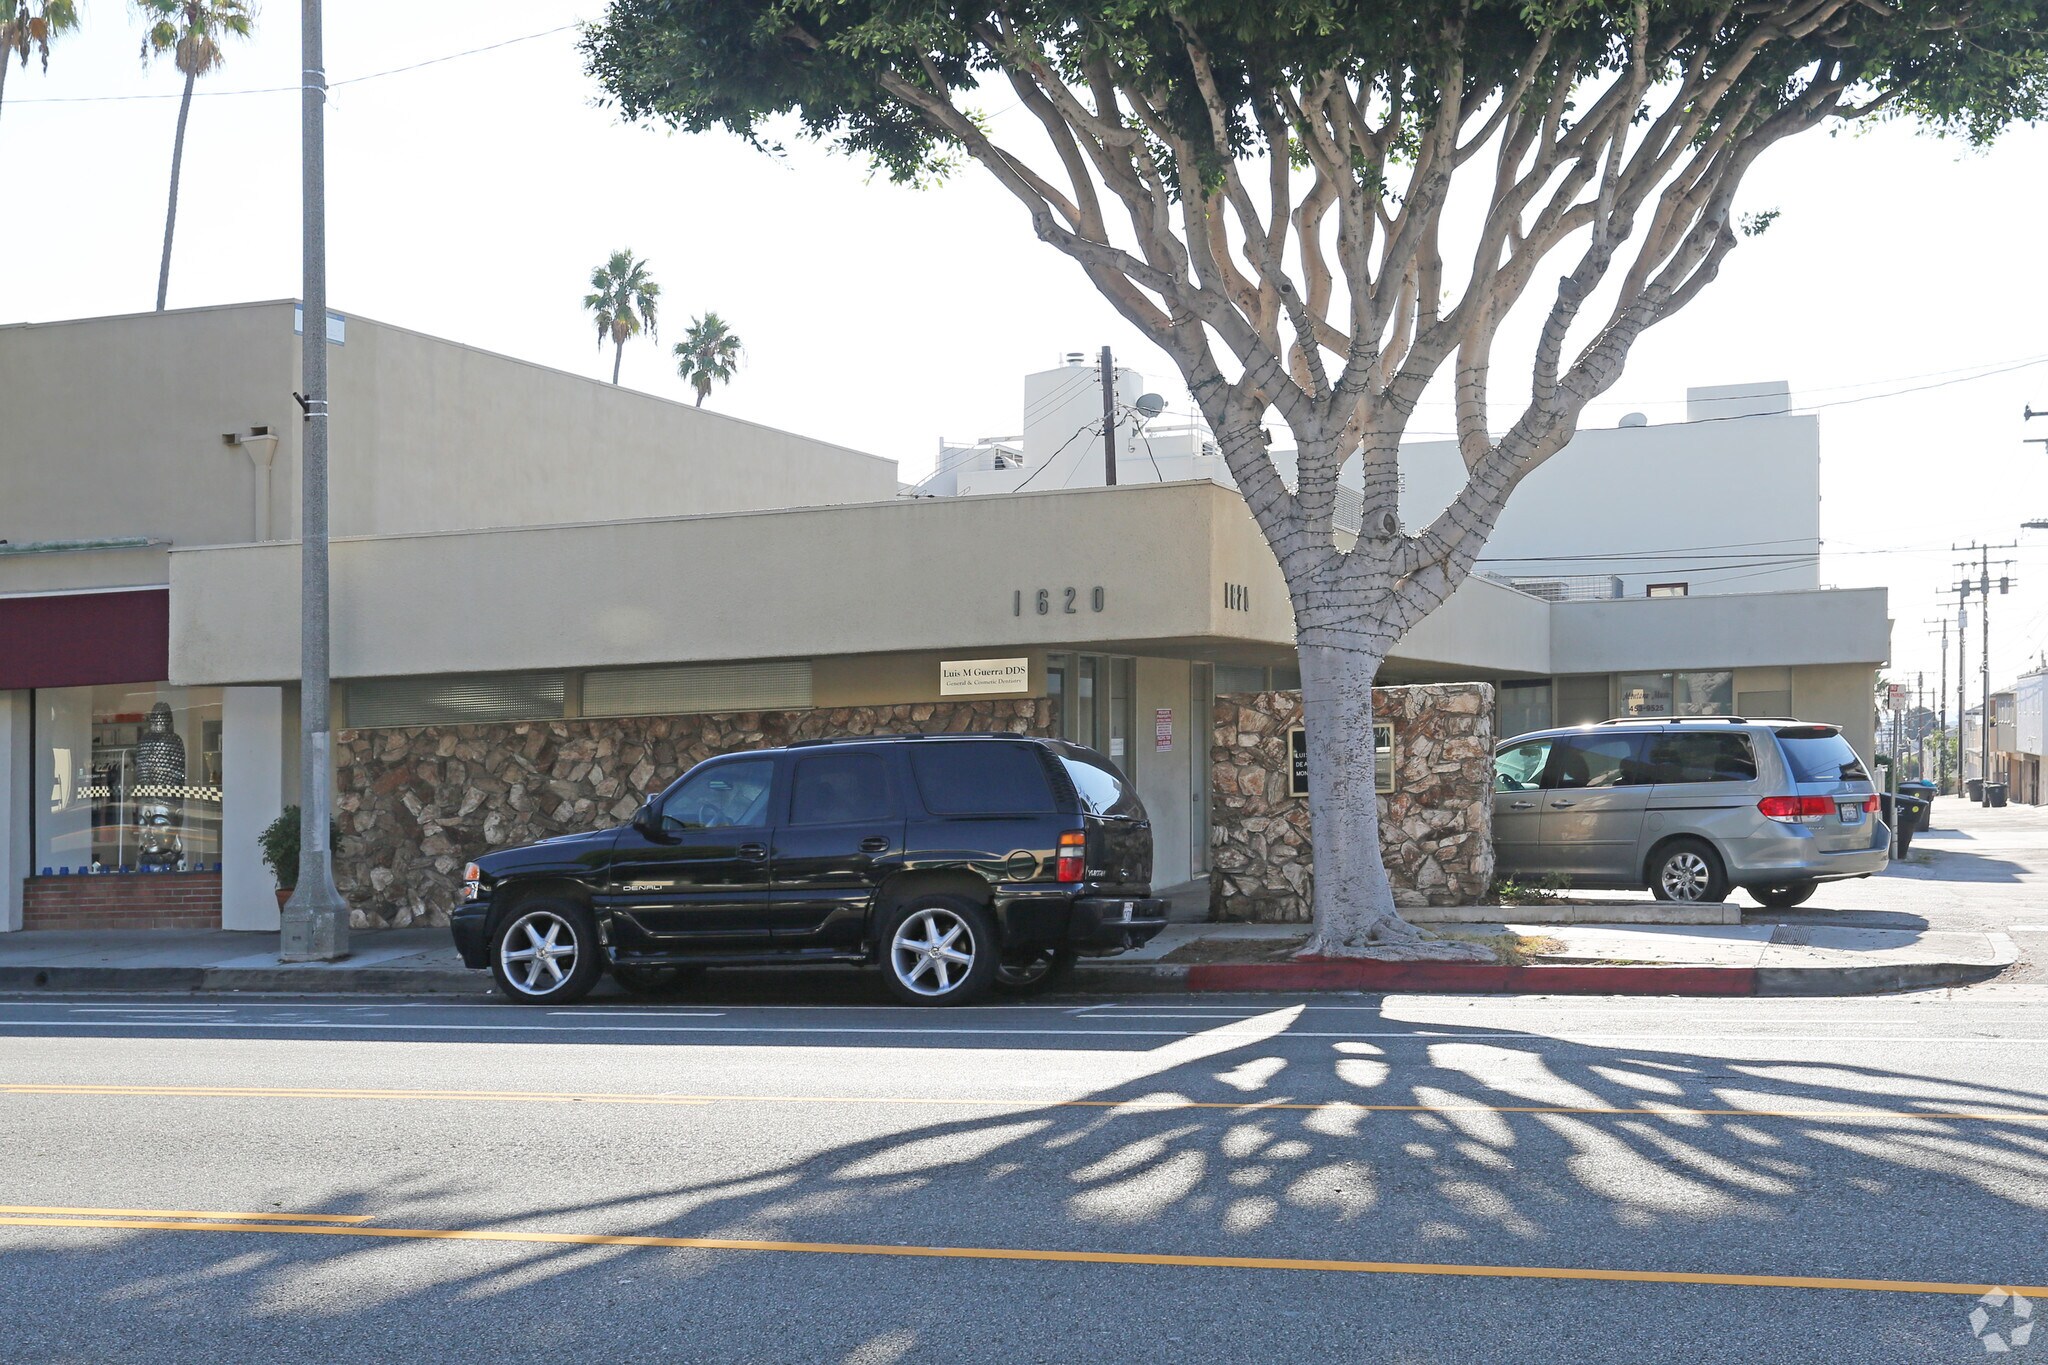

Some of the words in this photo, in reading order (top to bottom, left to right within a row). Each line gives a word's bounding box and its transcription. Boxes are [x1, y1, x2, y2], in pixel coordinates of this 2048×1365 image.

[1013, 585, 1105, 617] 1620
[943, 669, 961, 678] Luis
[963, 668, 972, 677] M
[973, 668, 1003, 676] Guerra
[1005, 665, 1026, 675] DDS
